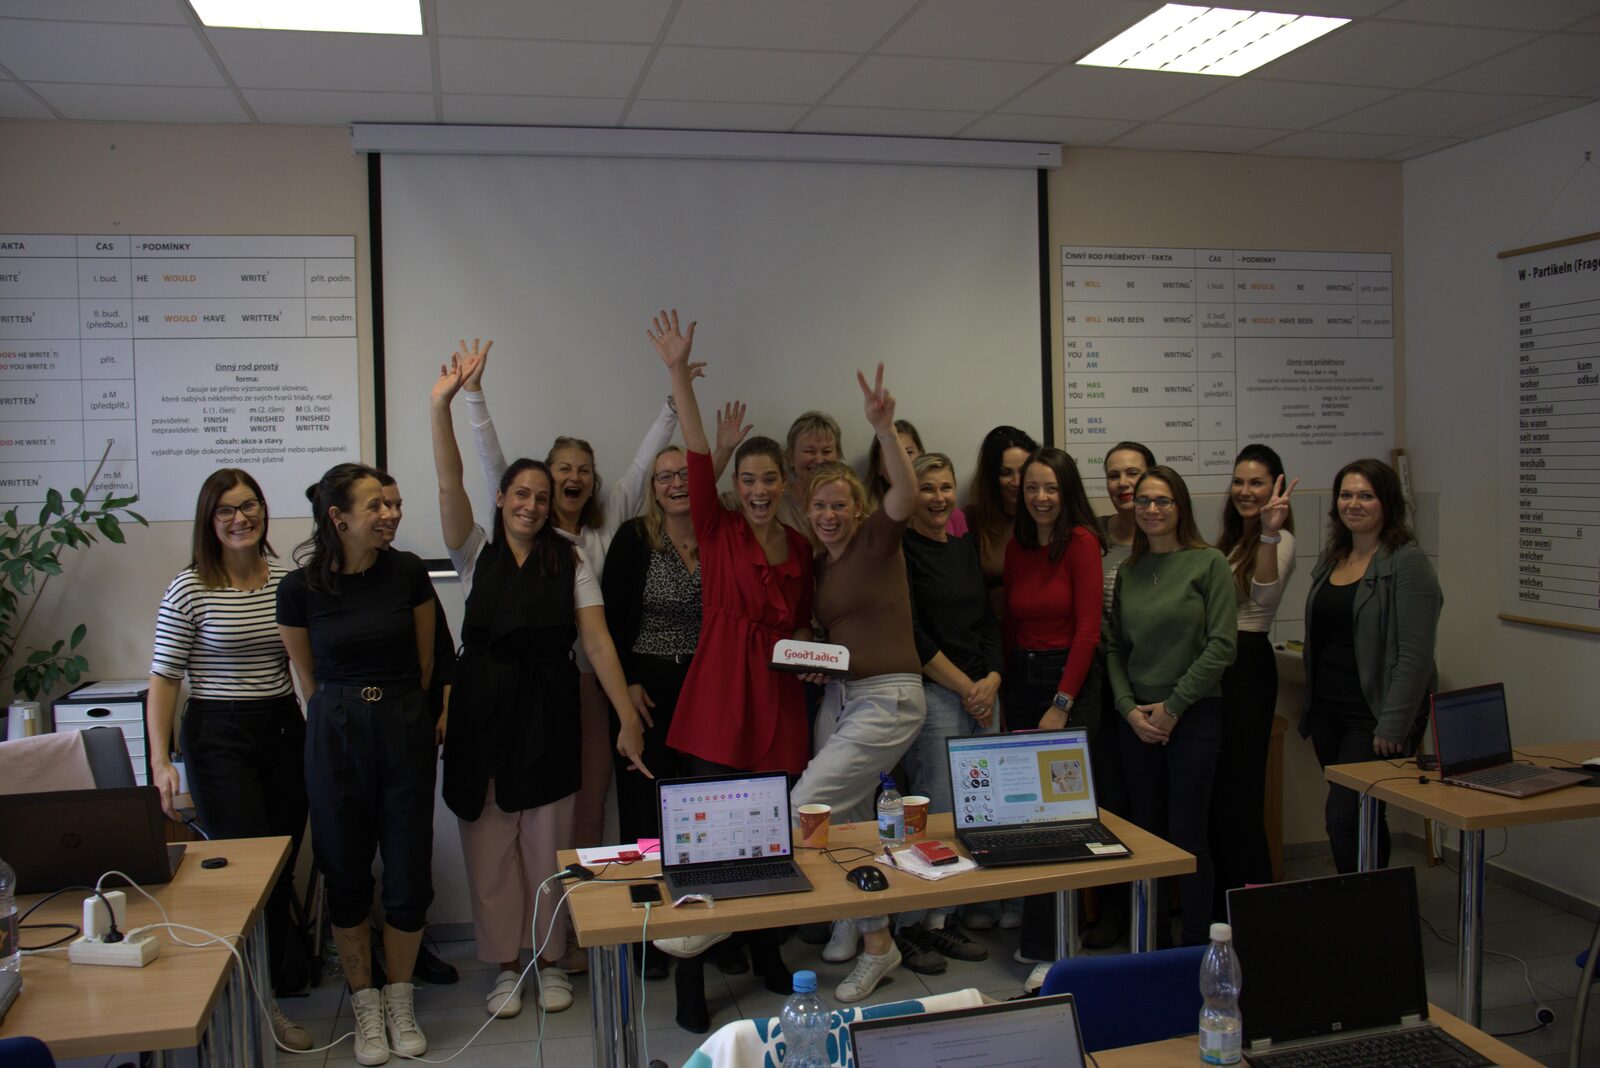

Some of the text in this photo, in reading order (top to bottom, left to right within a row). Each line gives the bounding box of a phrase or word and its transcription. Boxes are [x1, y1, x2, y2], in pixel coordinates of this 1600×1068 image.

[0, 242, 25, 250] AKTA
[96, 242, 114, 250] ČAS
[142, 242, 190, 251] PODMÍNKY
[1208, 254, 1222, 262] ČAS
[1518, 270, 1526, 280] W
[1533, 262, 1572, 278] Partikeln
[203, 314, 226, 322] HAVE
[238, 363, 252, 371] rod
[254, 363, 280, 372] prostý
[1577, 361, 1592, 370] kam
[1577, 374, 1599, 384] odkud
[1520, 485, 1538, 494] wieso
[1520, 498, 1531, 507] wie
[1520, 512, 1530, 520] wie
